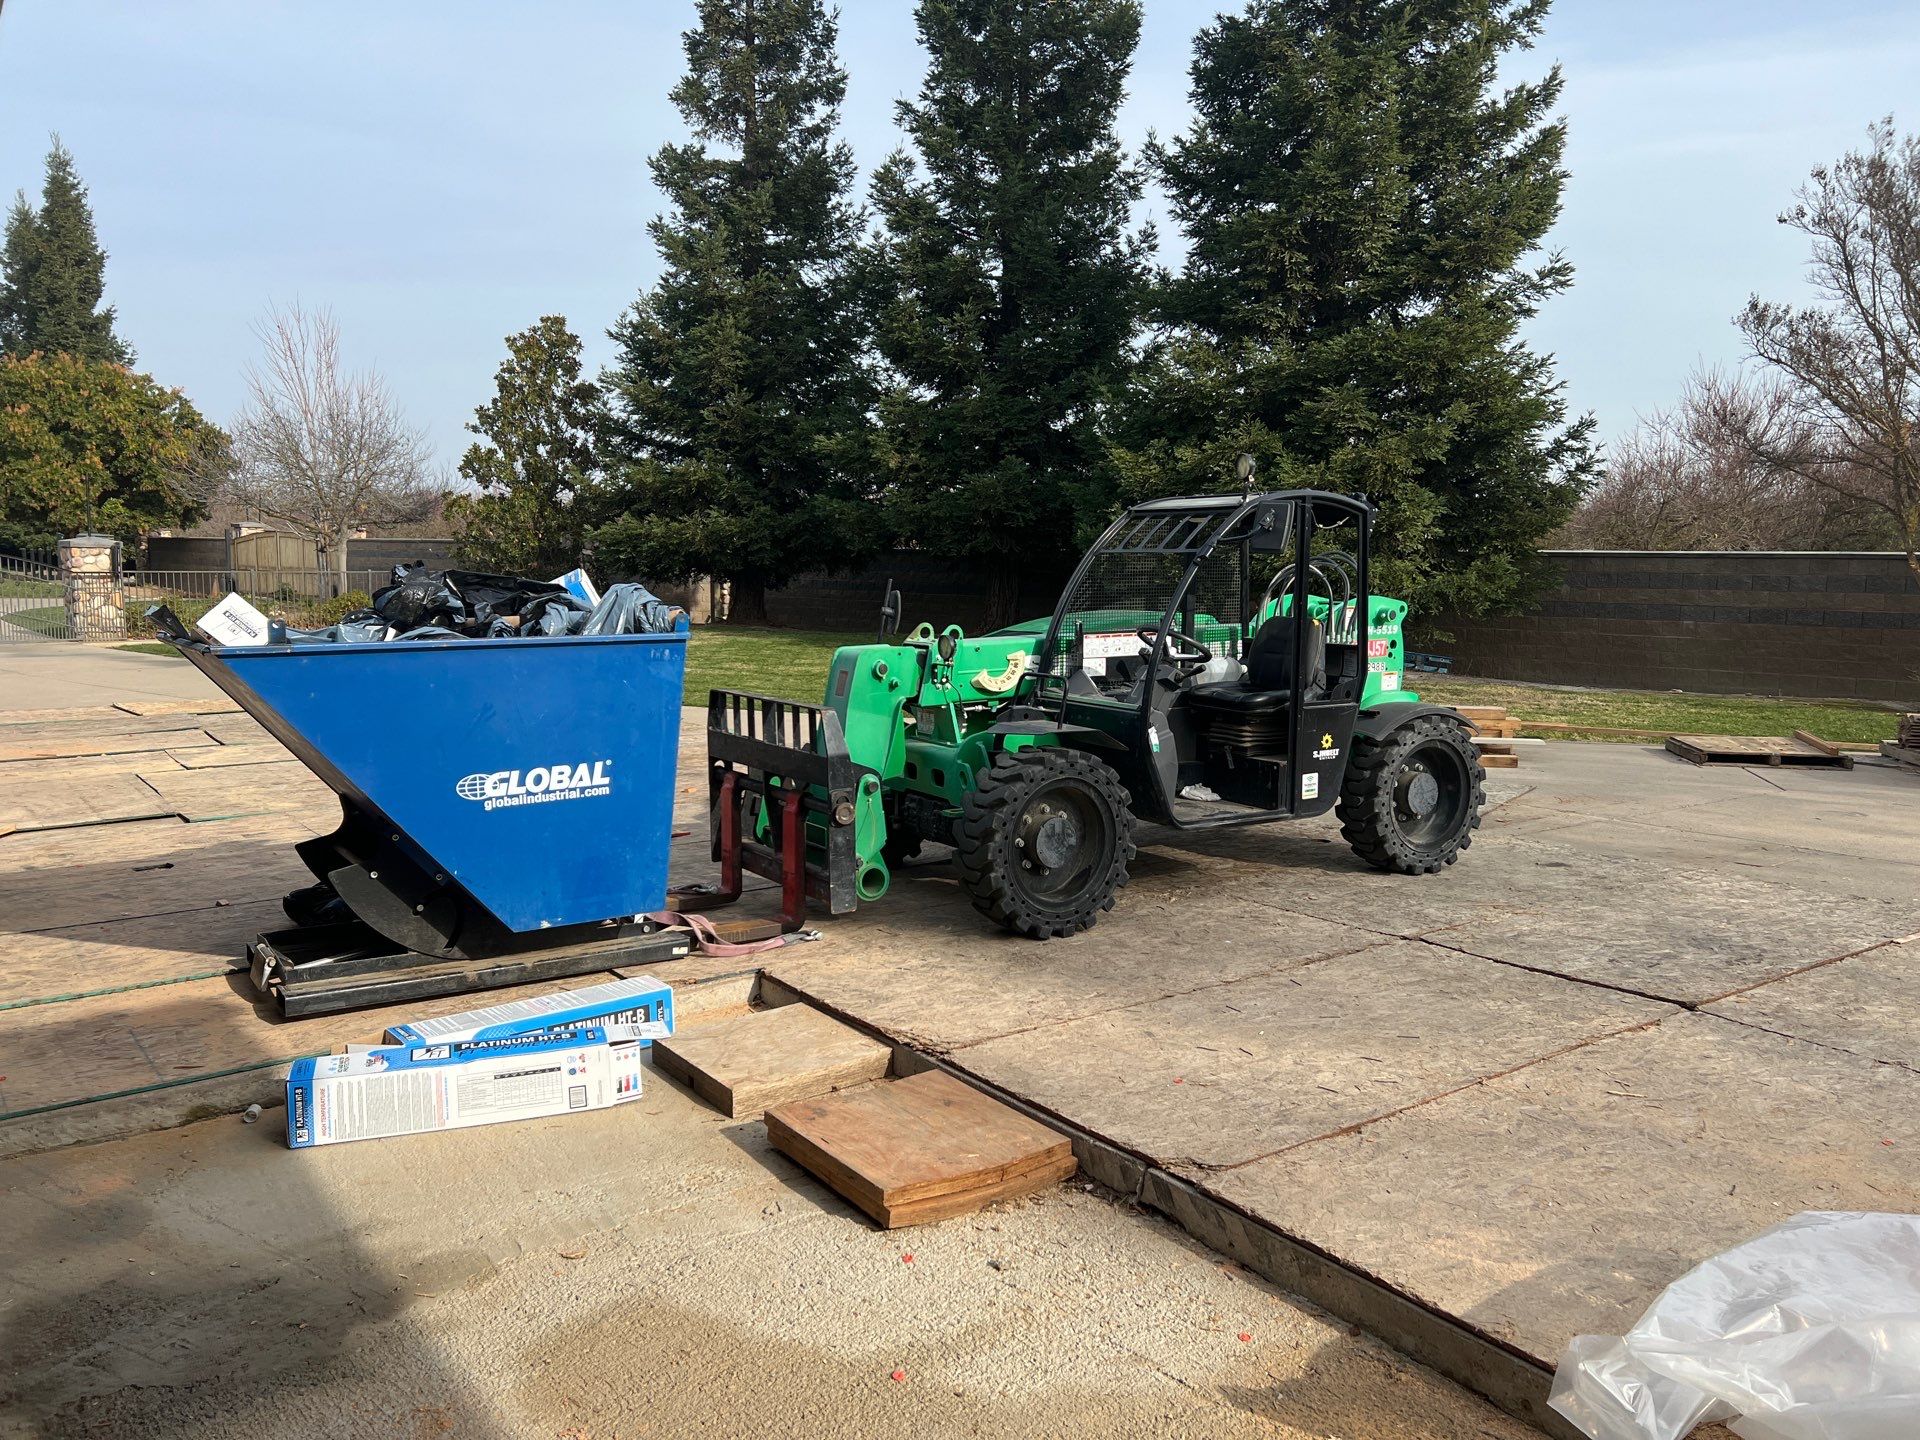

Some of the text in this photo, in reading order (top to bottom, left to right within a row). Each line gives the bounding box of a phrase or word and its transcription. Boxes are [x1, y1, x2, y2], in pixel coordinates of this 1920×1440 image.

[484, 760, 610, 797] GLOBAL
[483, 786, 610, 811] globalindustrial.com
[618, 1008, 646, 1025] HT-B
[461, 1033, 571, 1050] PLATINUM HT-B
[295, 1101, 304, 1127] PLATINUM
[319, 1088, 327, 1122] TEMPERATURE
